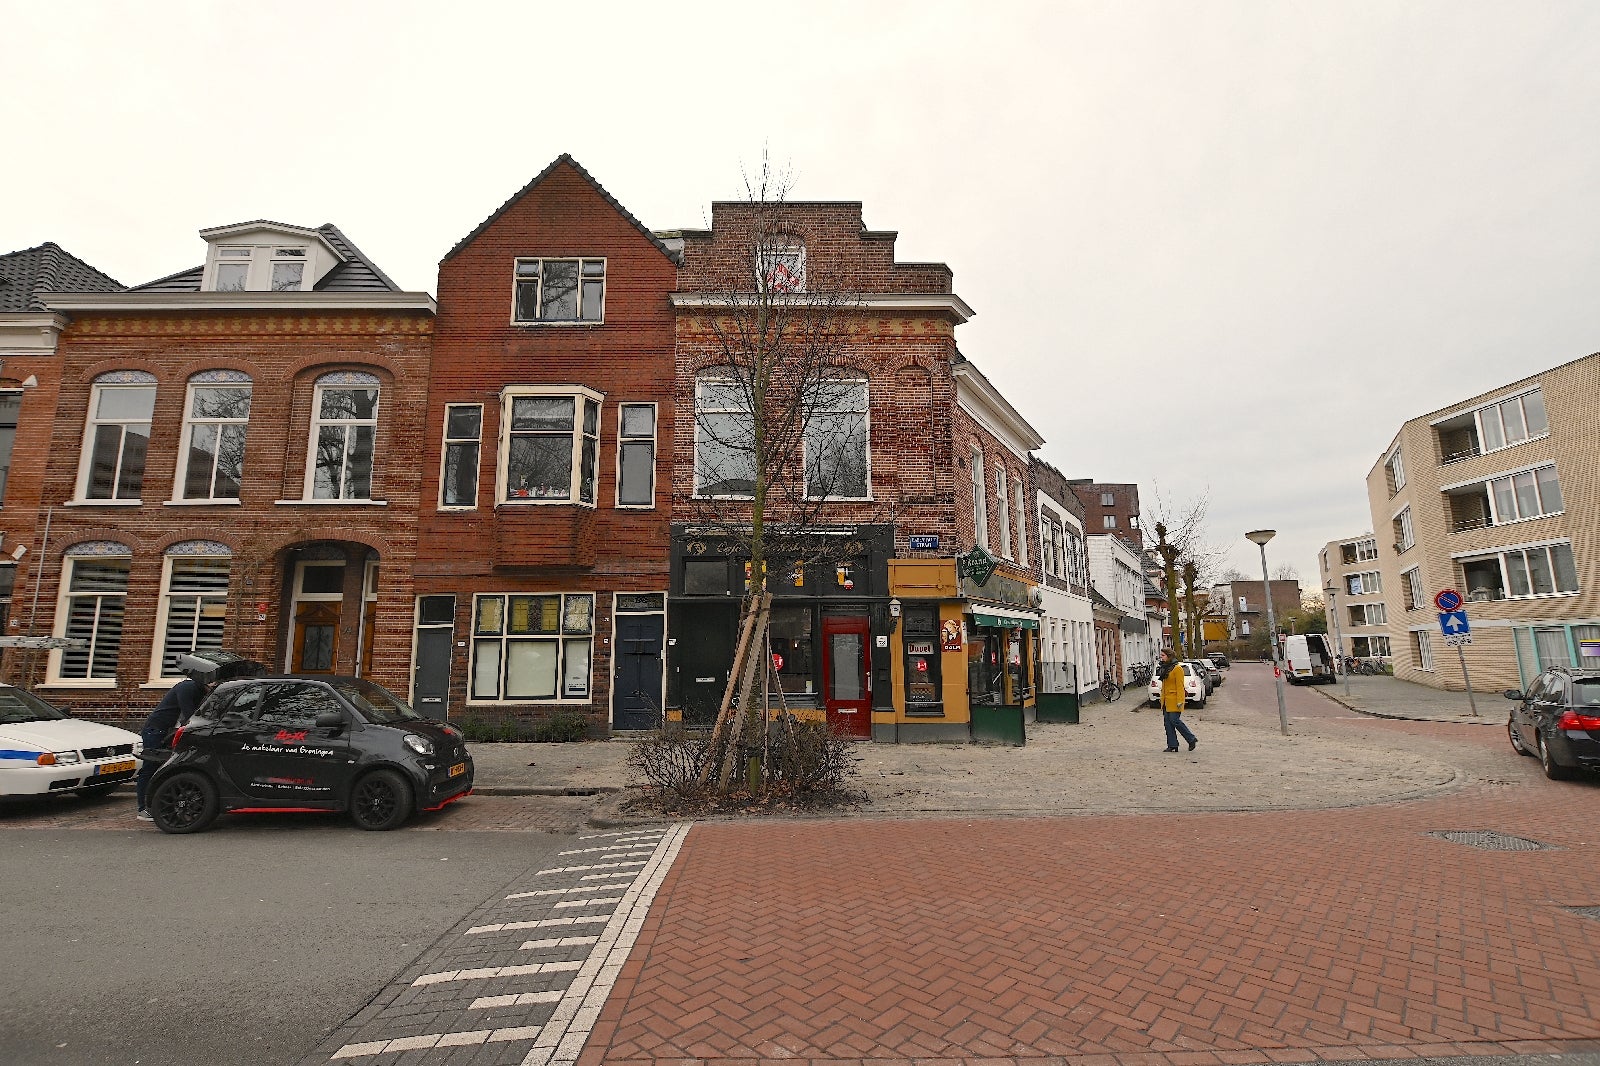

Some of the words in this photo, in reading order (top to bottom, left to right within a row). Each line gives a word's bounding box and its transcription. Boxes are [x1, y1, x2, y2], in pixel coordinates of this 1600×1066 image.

[909, 644, 931, 653] Duvel
[252, 744, 283, 753] makelaar
[299, 746, 334, 757] Groningen
